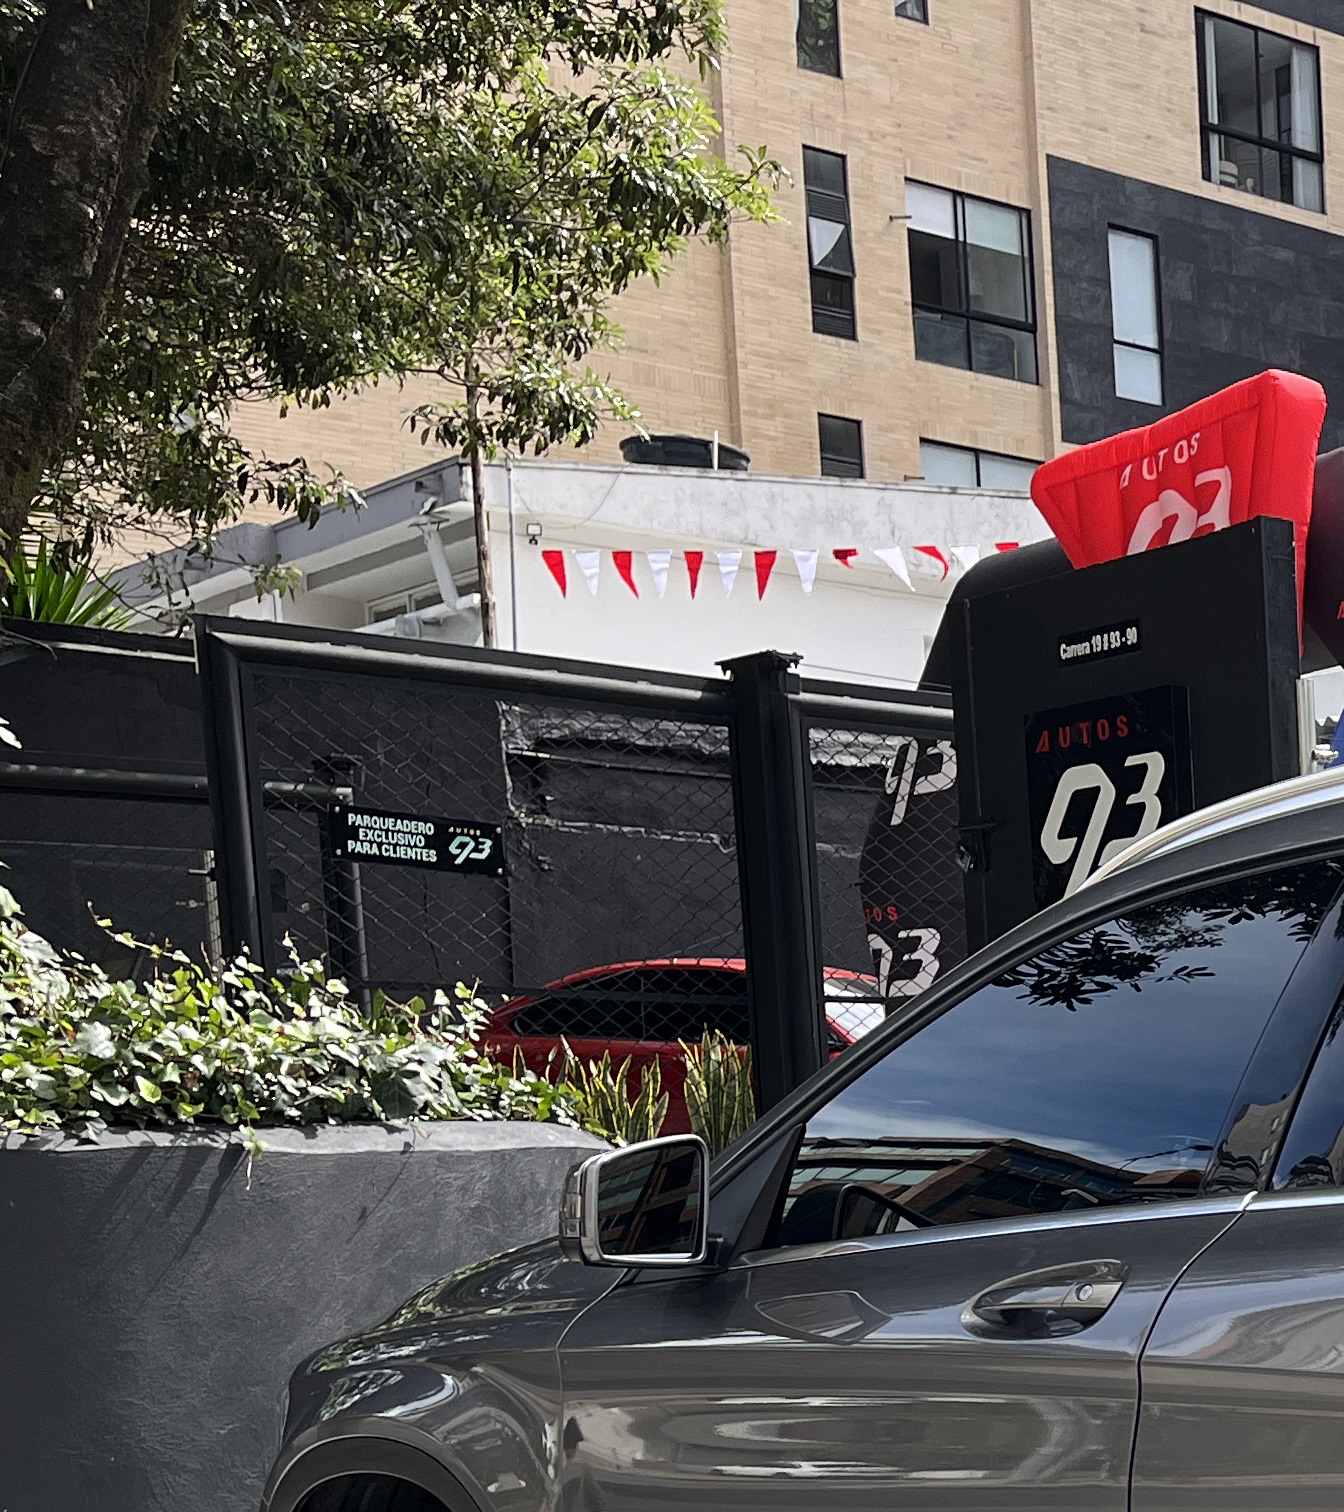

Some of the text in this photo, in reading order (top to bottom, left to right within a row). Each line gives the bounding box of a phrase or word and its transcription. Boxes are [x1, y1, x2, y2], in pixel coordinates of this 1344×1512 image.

[1120, 432, 1200, 489] AUTOS
[1060, 641, 1091, 660] Carrera
[1091, 634, 1102, 653] 19
[1110, 630, 1121, 649] 93
[1035, 714, 1129, 753] AUTOS
[347, 813, 435, 836] PARQUEADERO
[358, 828, 425, 848] EXCLUSIVO
[1040, 751, 1165, 899] 93
[347, 840, 437, 863] PARA CLIENTES
[449, 836, 493, 865] 93
